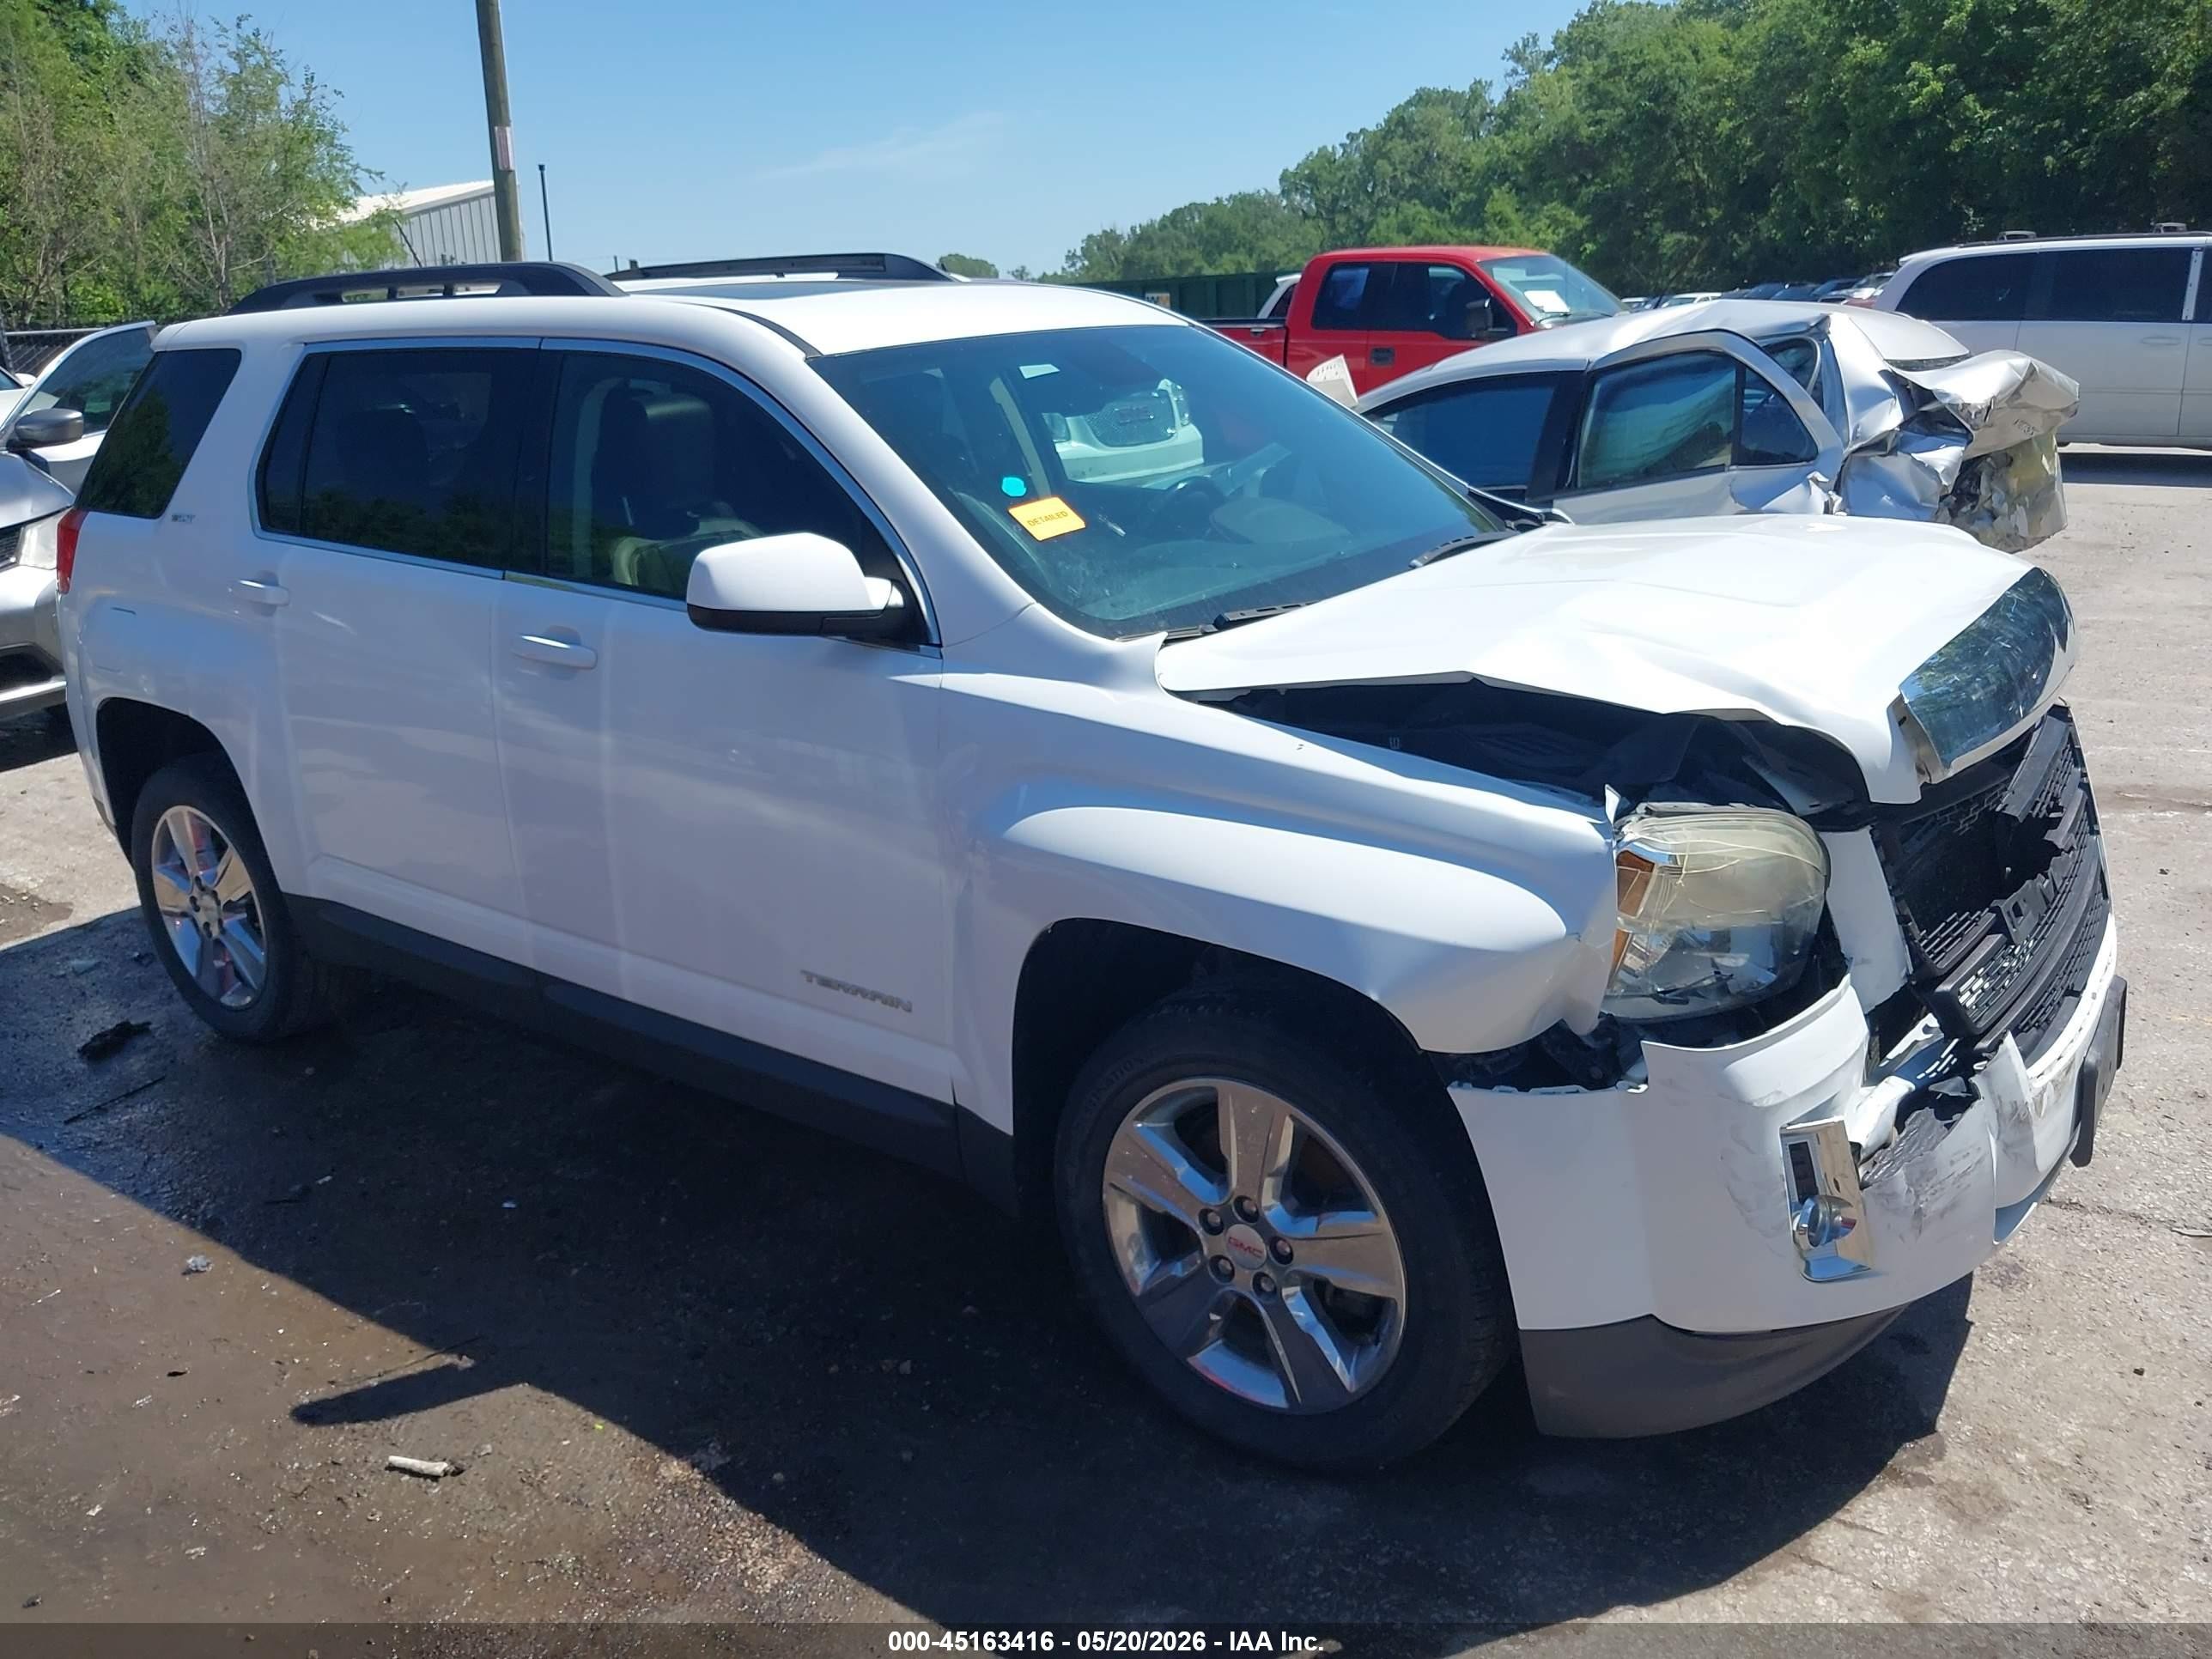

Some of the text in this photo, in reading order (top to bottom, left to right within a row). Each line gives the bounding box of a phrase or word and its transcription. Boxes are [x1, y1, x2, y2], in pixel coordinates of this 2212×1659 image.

[1026, 510, 1069, 527] DETAILED
[800, 969, 913, 1013] TERRAIN
[1228, 1237, 1264, 1259] GMC
